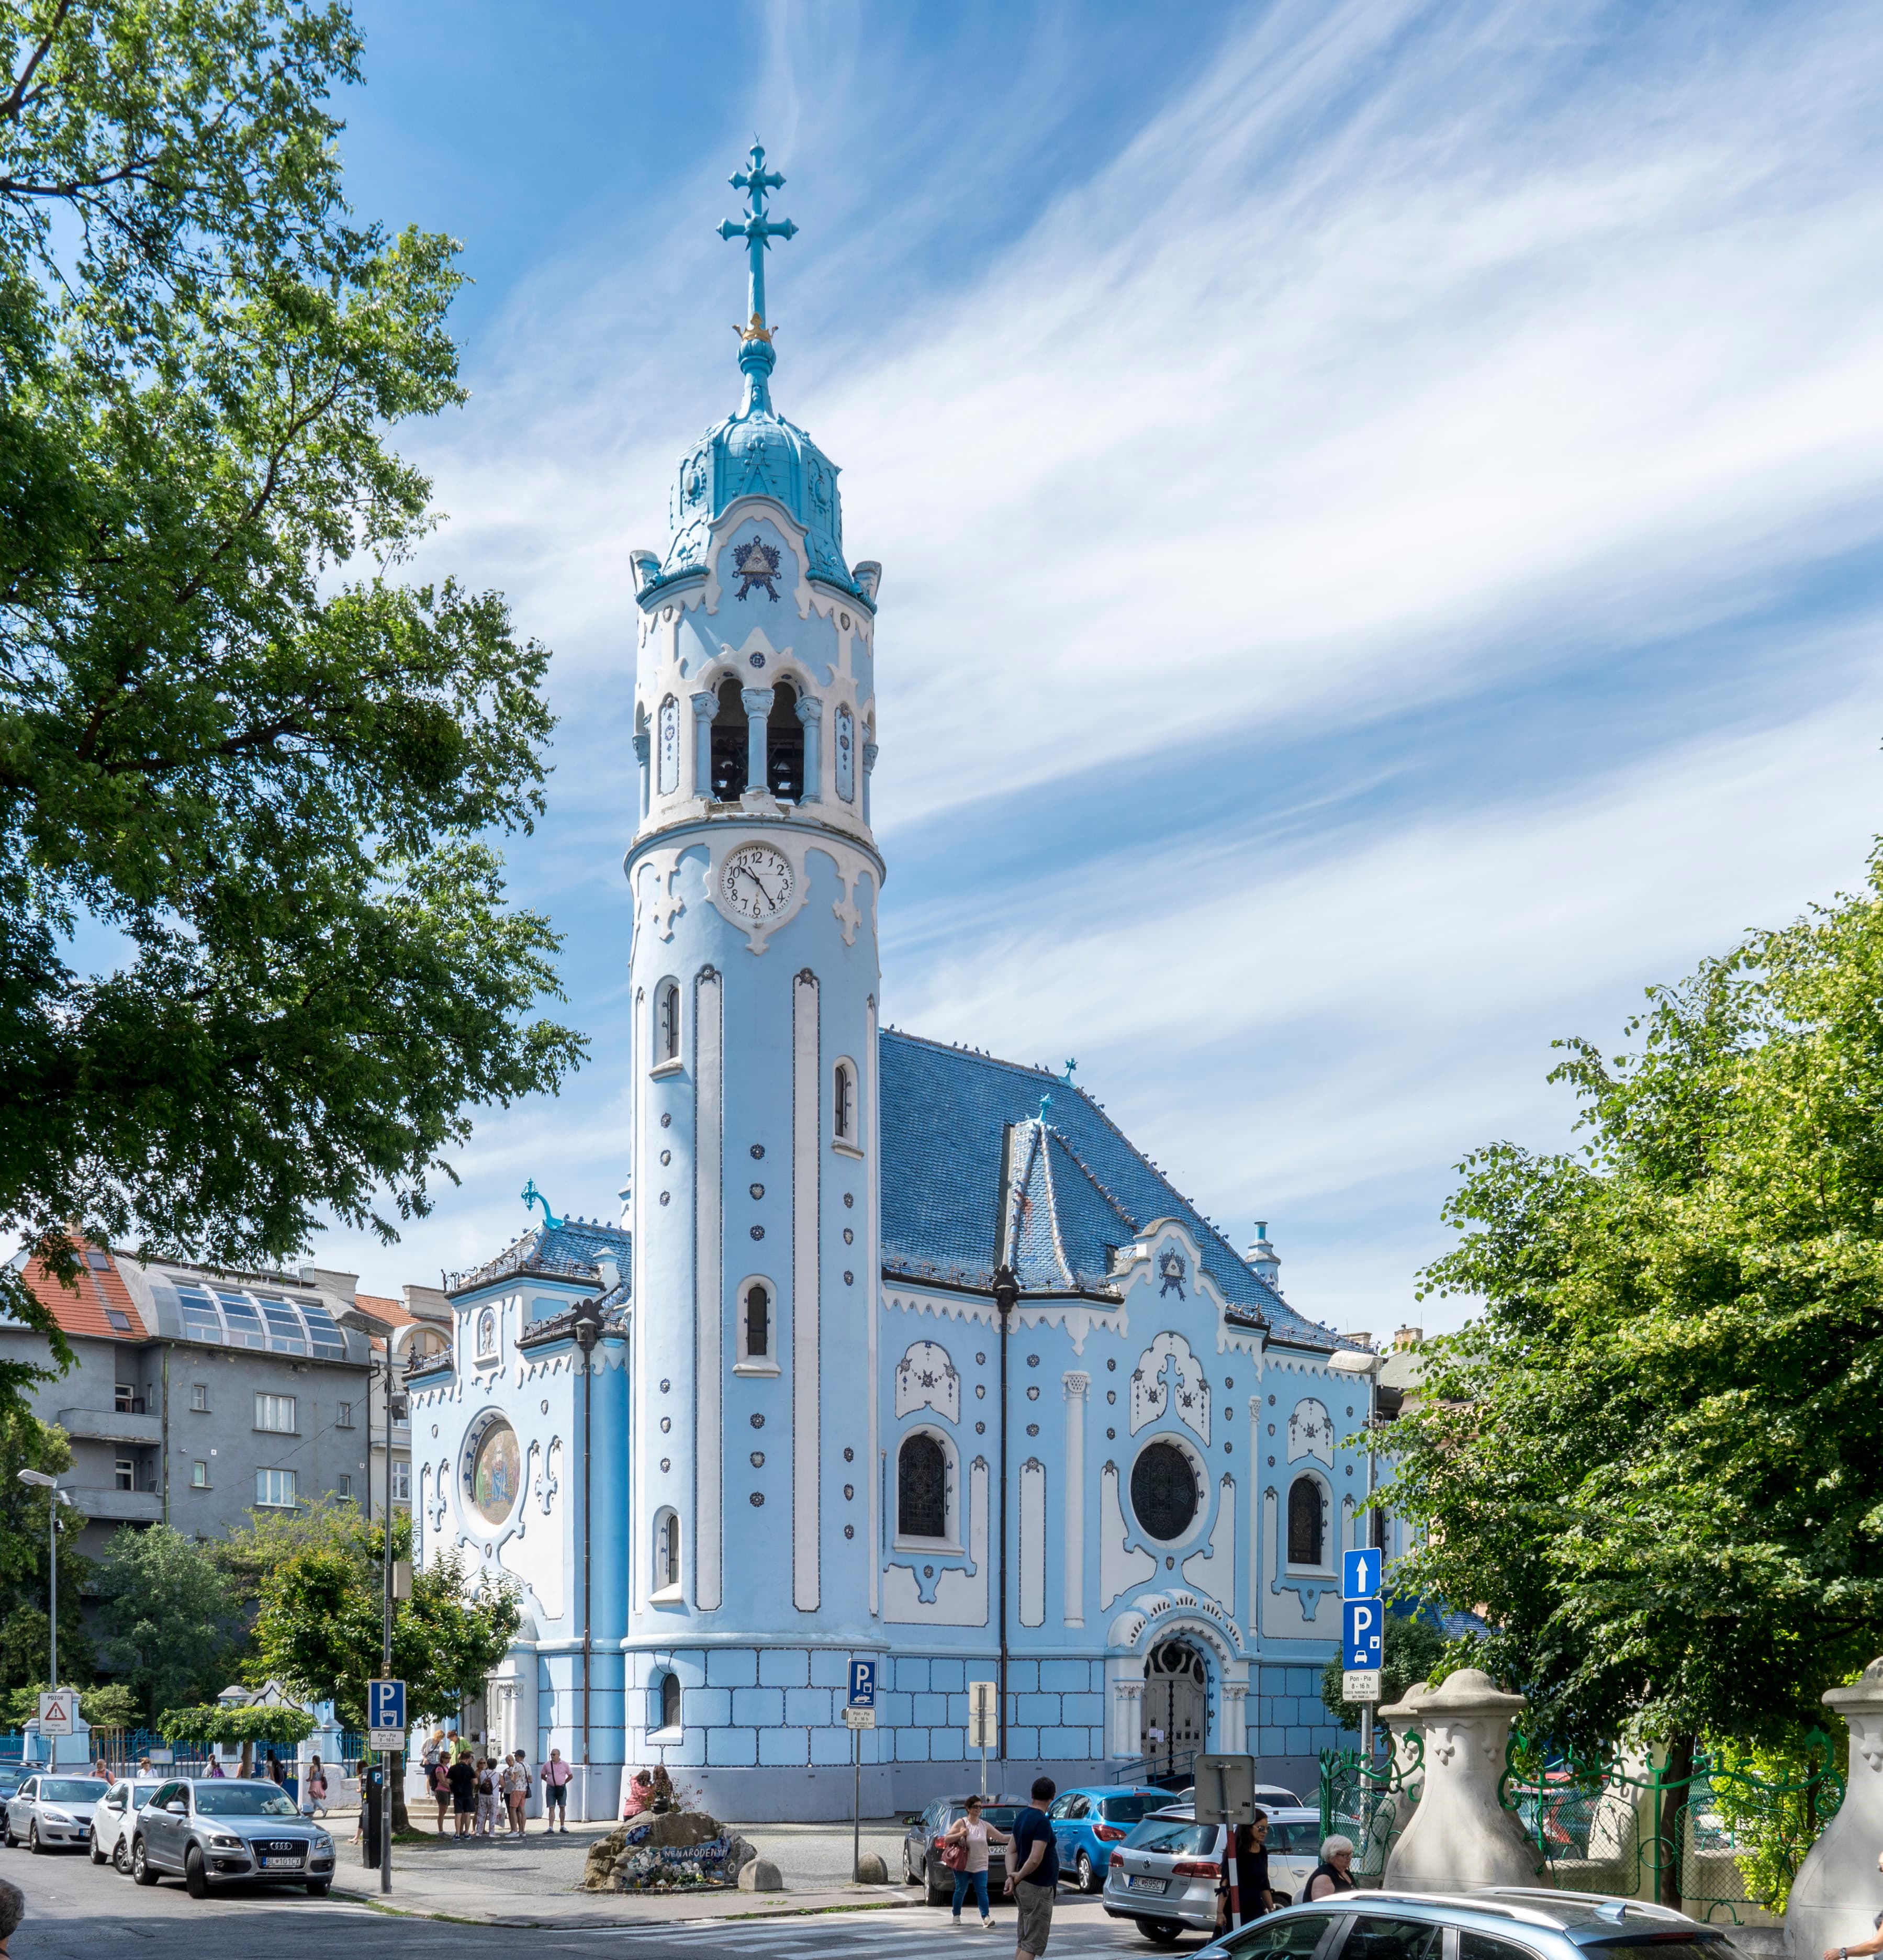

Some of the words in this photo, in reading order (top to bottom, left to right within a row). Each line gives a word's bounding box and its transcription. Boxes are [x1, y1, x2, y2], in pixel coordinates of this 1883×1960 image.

[737, 854, 747, 866] 11
[751, 851, 763, 864] 12
[768, 857, 774, 867] 1
[729, 866, 740, 878] 10
[777, 864, 784, 876] 2
[727, 878, 735, 889] 9
[782, 879, 789, 890] 3
[731, 889, 738, 901] 8
[777, 890, 786, 904] 4
[741, 899, 749, 910] 7
[753, 902, 761, 915] 6
[768, 899, 776, 911] 5
[1354, 1607, 1372, 1645] P
[857, 1664, 869, 1690] P
[380, 1684, 395, 1709] P
[375, 1773, 381, 1783] P
[1134, 1877, 1141, 1887] BL
[1144, 1879, 1165, 1889] 695CT
